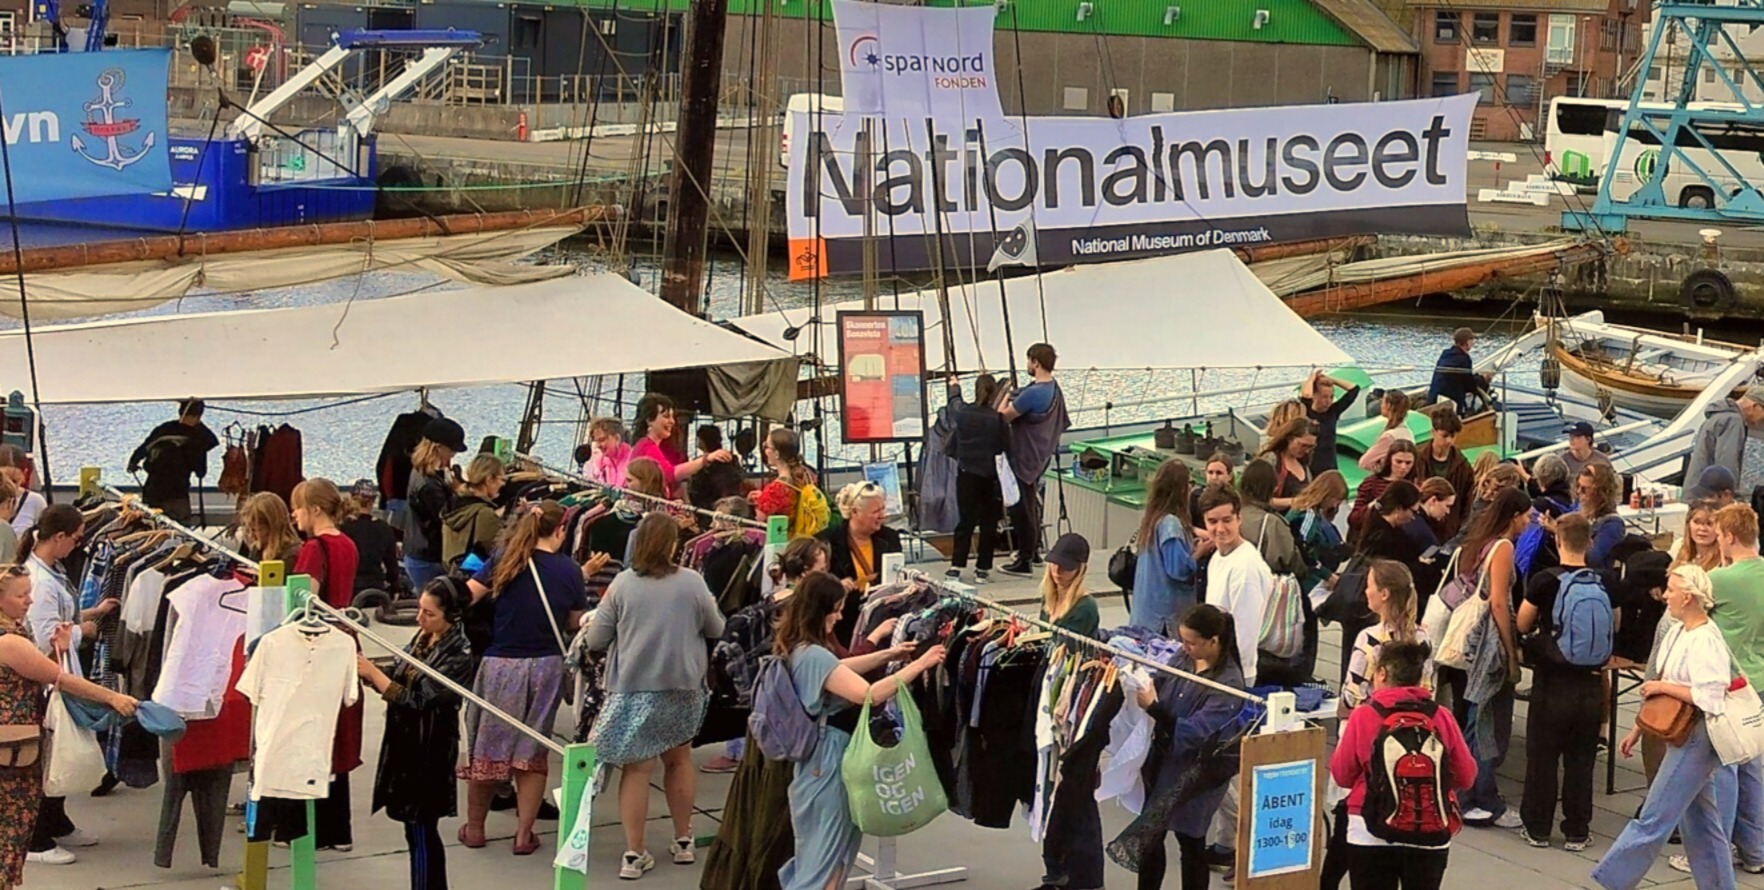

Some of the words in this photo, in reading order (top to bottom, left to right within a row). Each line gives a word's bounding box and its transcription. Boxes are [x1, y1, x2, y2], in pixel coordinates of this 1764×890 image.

[935, 77, 986, 89] FONDEN
[170, 146, 199, 155] AURORA
[803, 115, 1451, 218] Nationalmuseet
[1071, 235, 1130, 255] National
[1131, 234, 1194, 251] Museum
[1195, 231, 1212, 246] of
[1212, 226, 1272, 246] Denmark
[873, 752, 916, 782] IGEN
[875, 782, 906, 799] OG
[879, 786, 925, 816] IGEN
[1261, 792, 1306, 811] ÅBENT
[1268, 816, 1293, 830] idag
